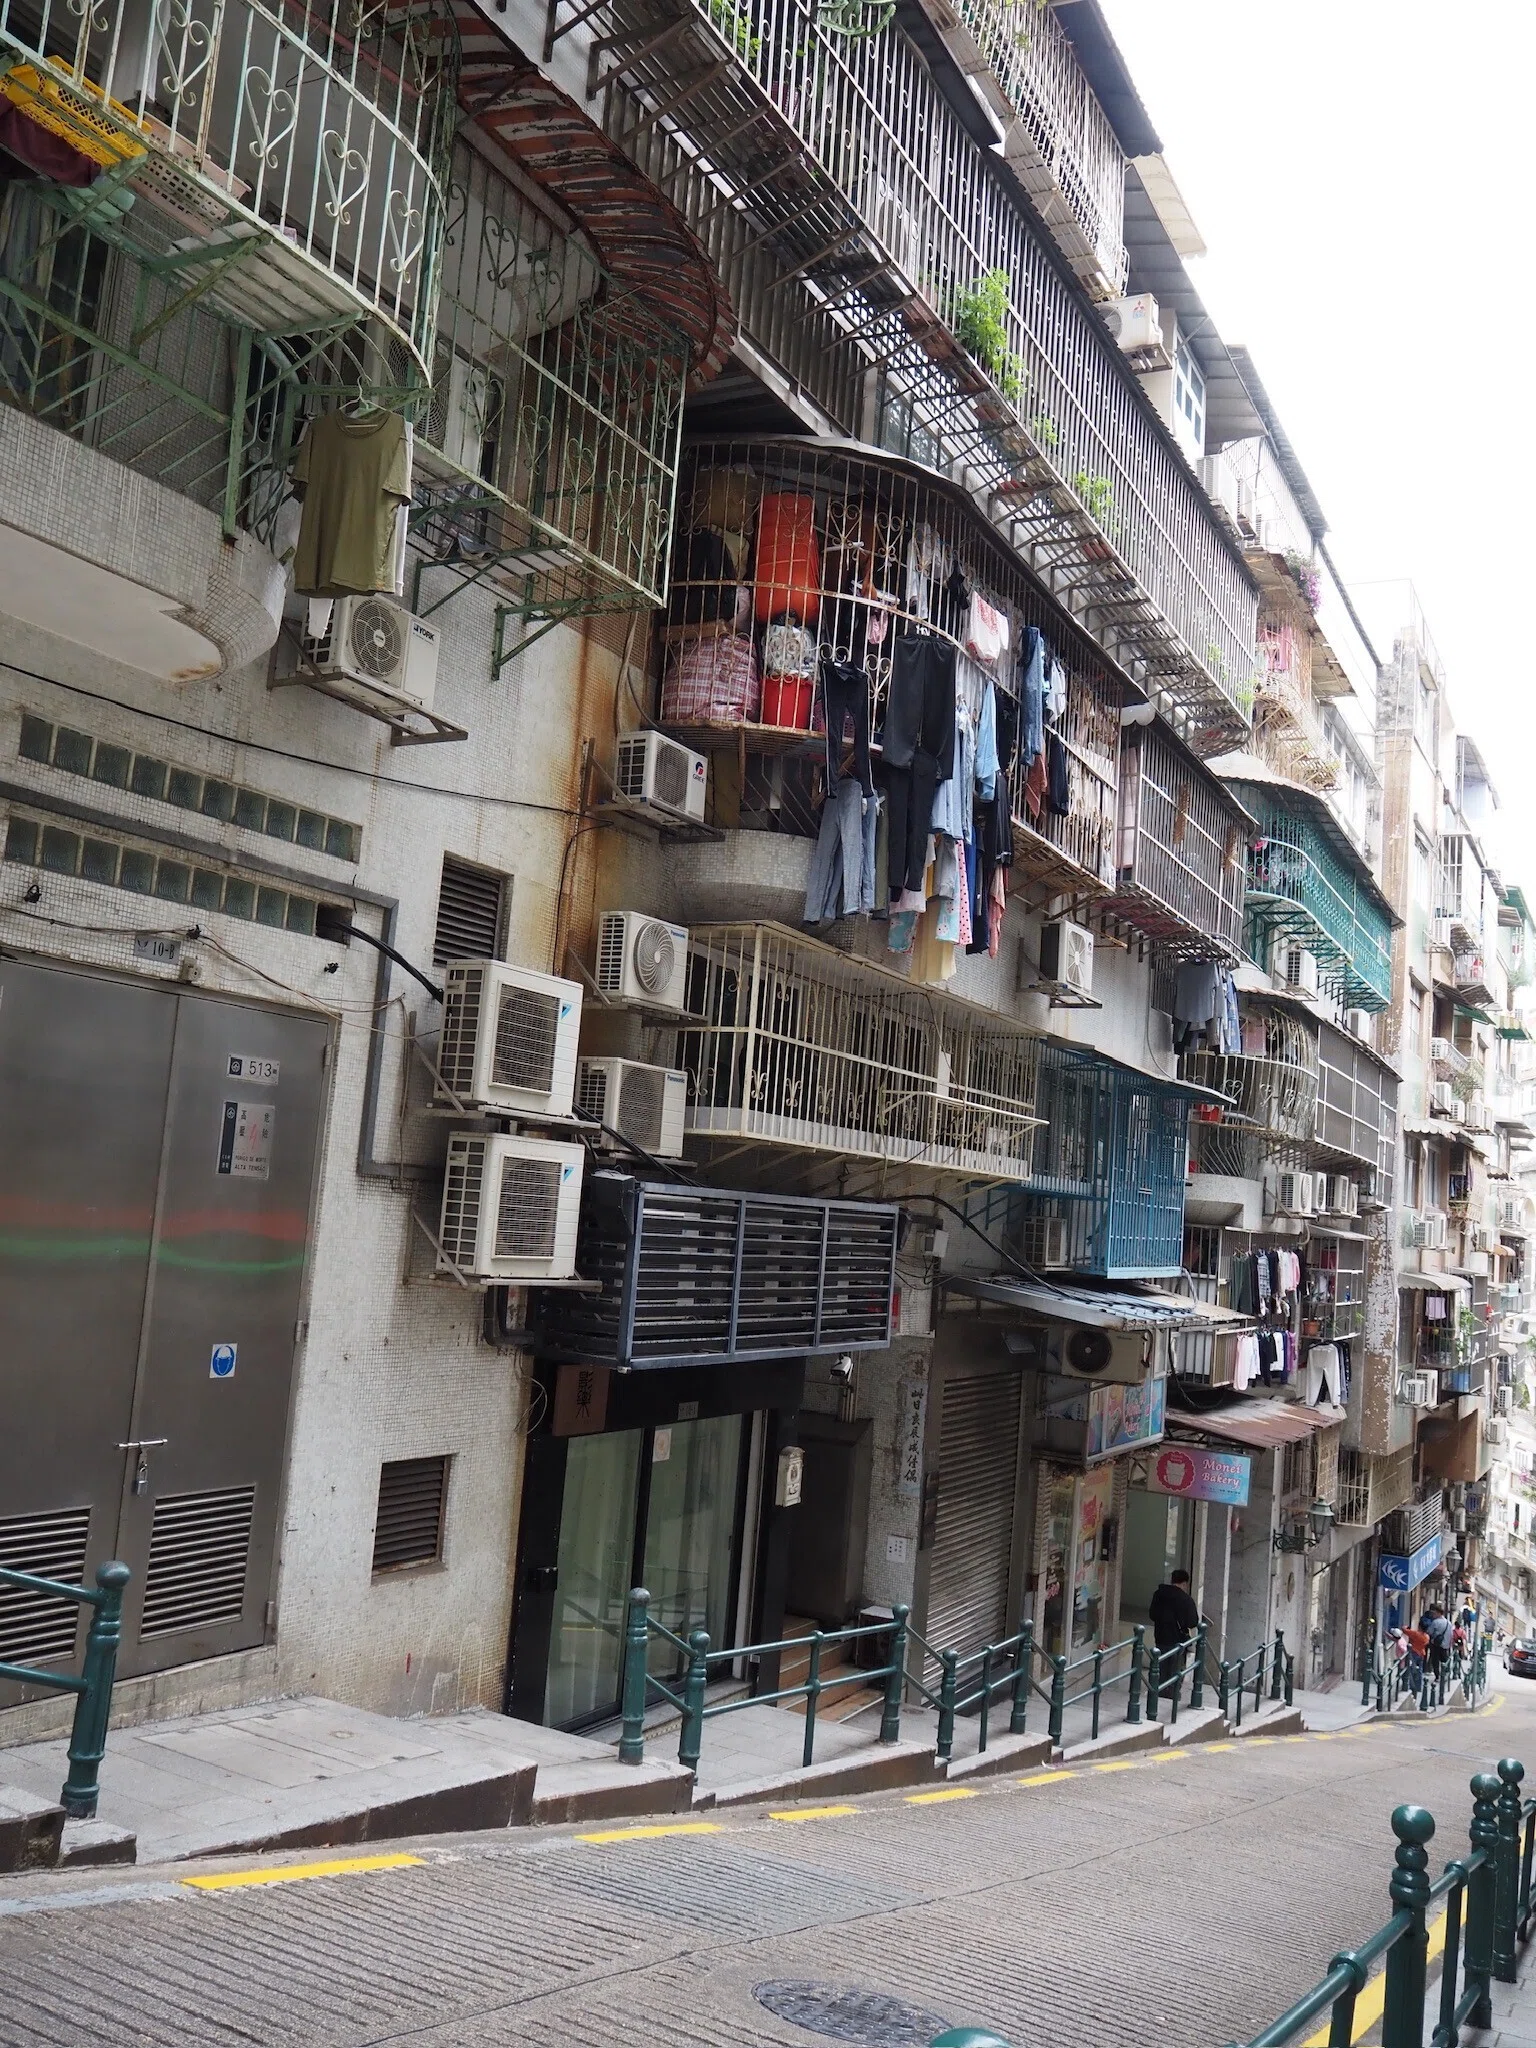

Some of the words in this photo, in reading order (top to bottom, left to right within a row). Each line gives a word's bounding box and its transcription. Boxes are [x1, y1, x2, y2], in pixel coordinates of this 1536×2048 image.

[693, 773, 705, 784] GREE
[152, 941, 175, 960] 10-B
[249, 1061, 272, 1077] 513
[1202, 1473, 1241, 1490] Bakery
